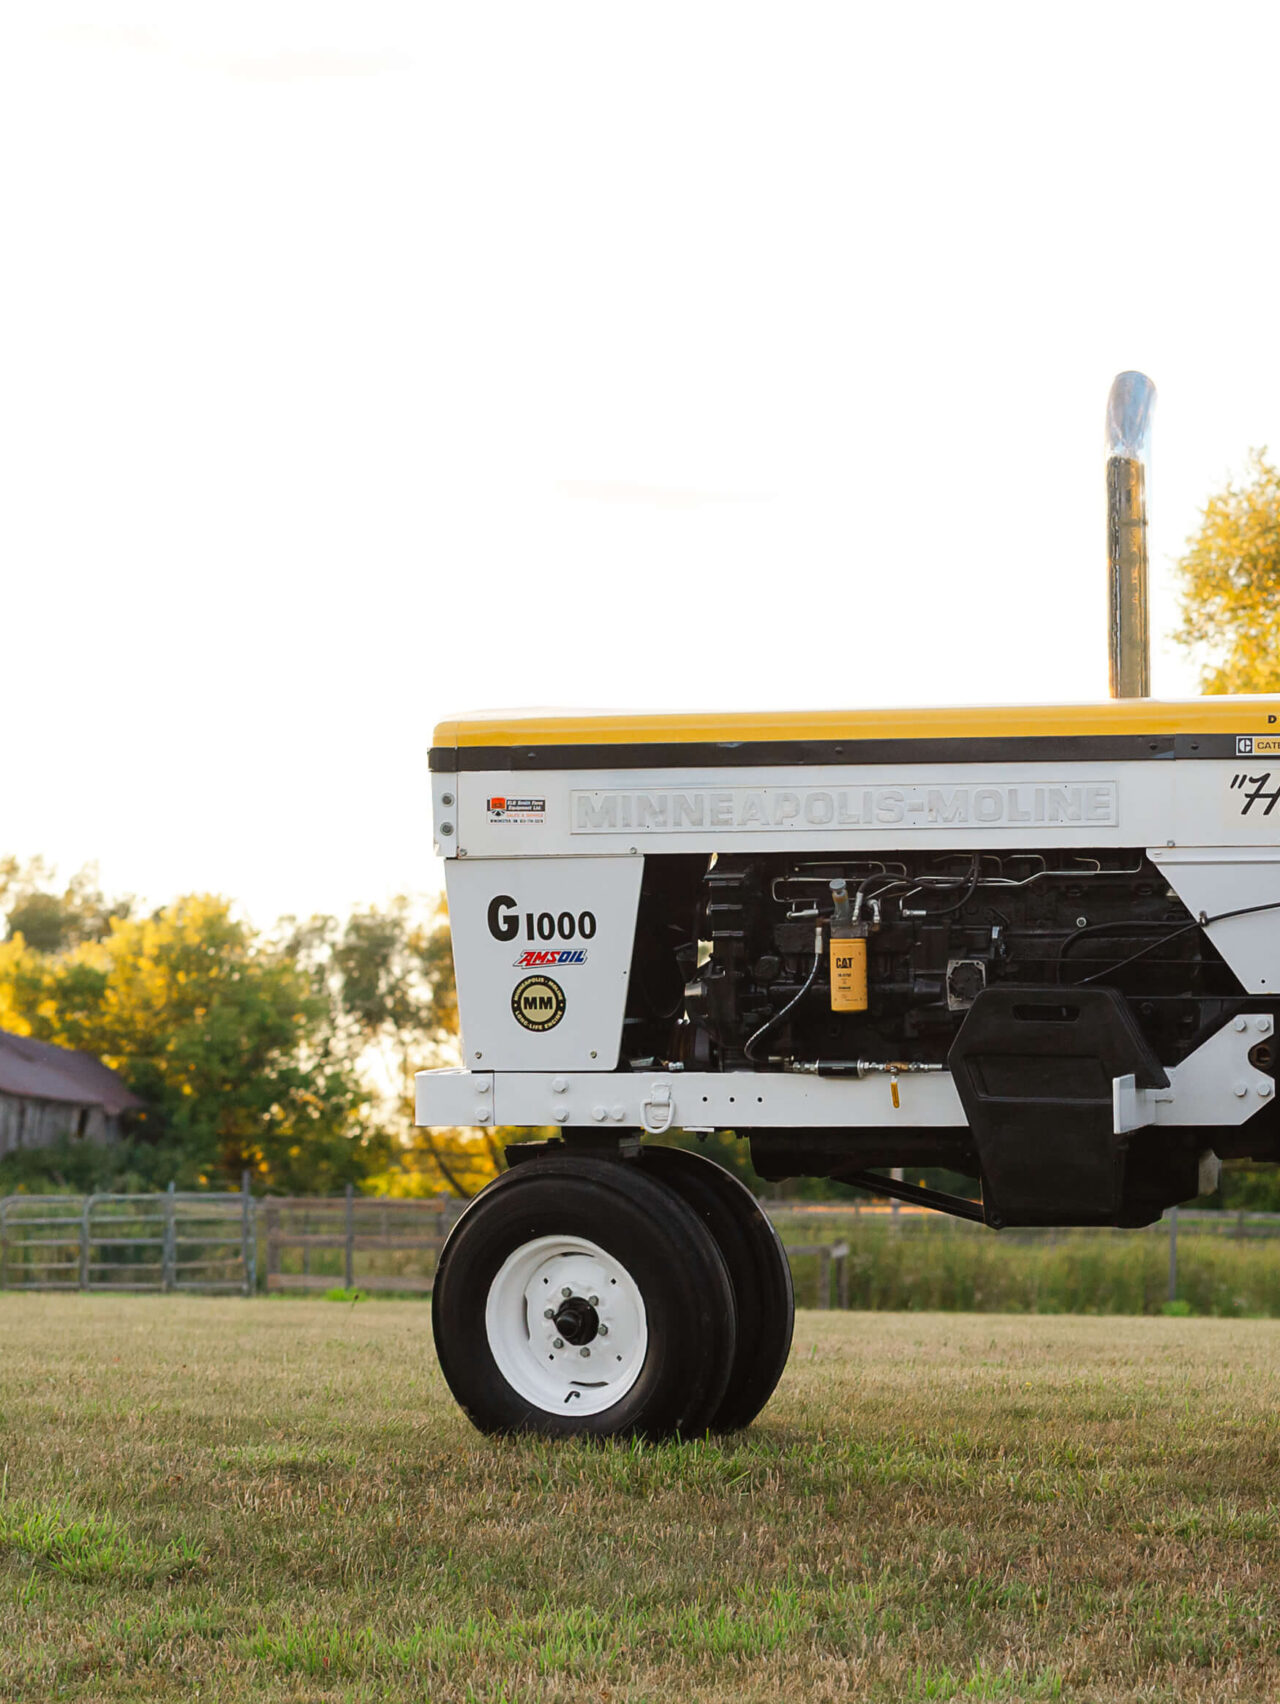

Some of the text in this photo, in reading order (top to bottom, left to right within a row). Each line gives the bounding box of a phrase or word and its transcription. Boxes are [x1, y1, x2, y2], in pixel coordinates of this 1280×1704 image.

[576, 785, 1113, 829] MINNEAPOLIS-MOLINE
[517, 950, 585, 967] AMSOIL
[836, 957, 854, 969] CAT
[523, 996, 553, 1010] MM
